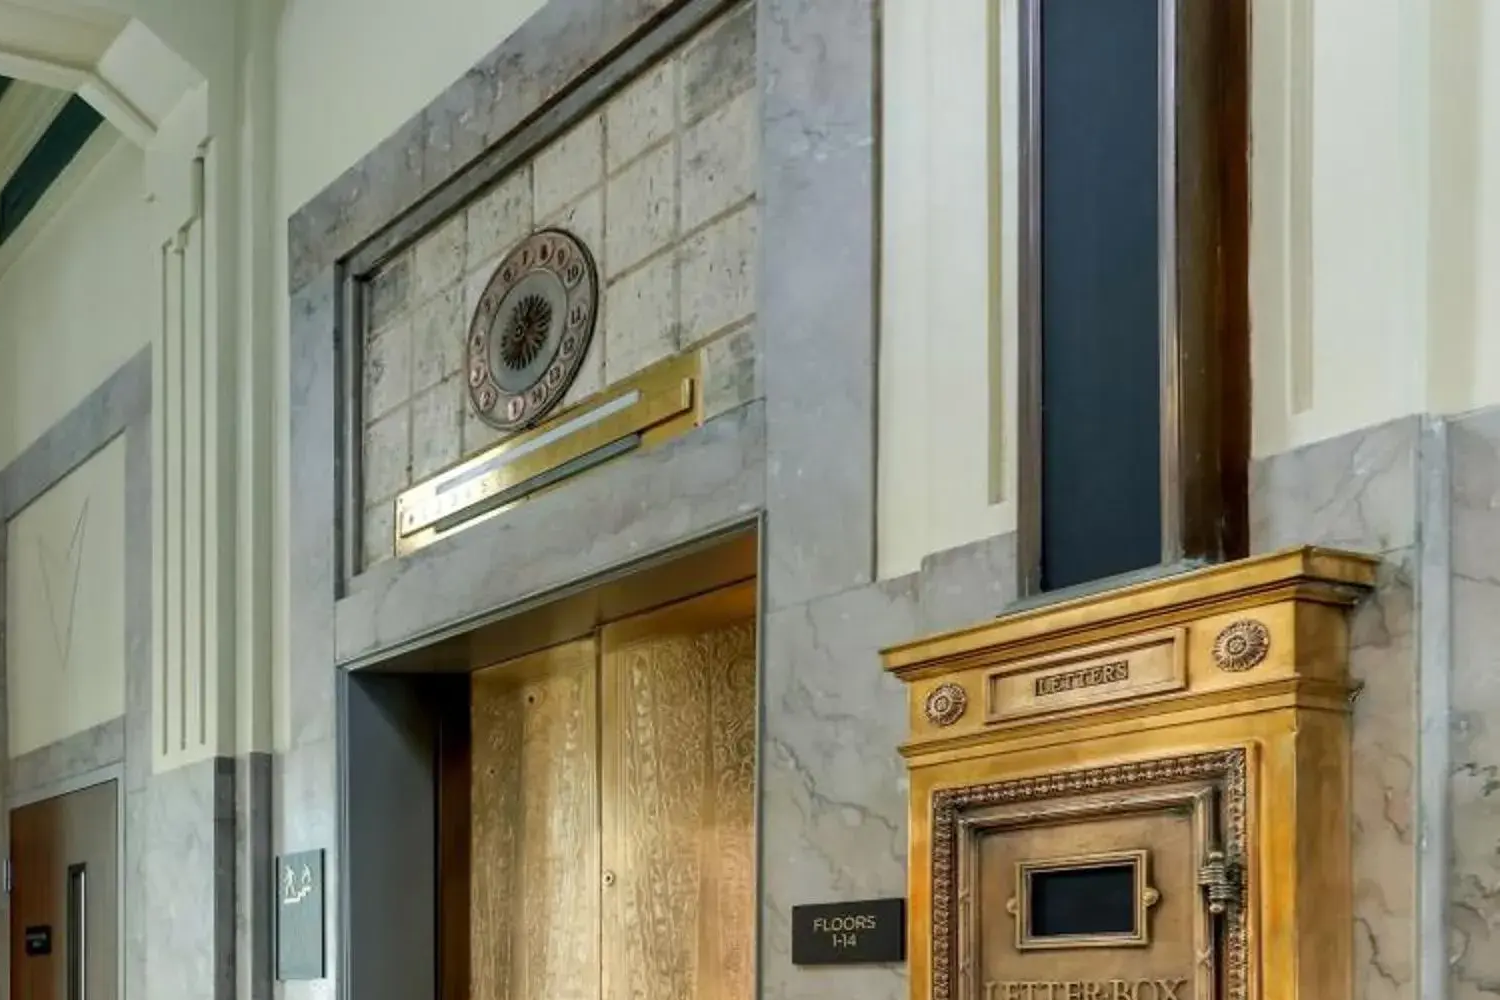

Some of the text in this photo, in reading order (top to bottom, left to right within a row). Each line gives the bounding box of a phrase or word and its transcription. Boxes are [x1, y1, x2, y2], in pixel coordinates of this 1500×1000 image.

[1036, 661, 1129, 696] LETTERS
[813, 915, 877, 933] FLOORS
[832, 933, 858, 948] 1-14
